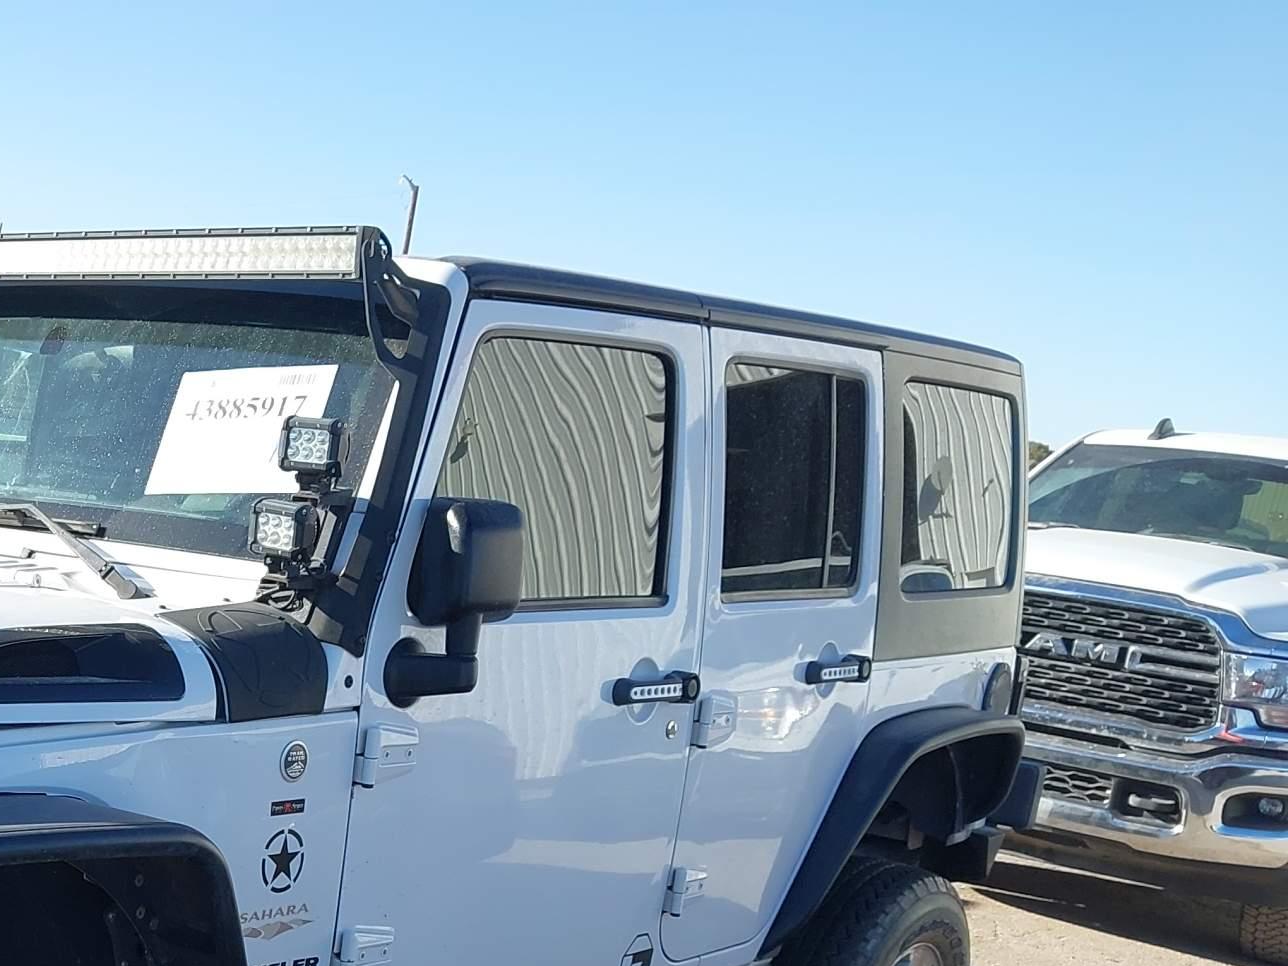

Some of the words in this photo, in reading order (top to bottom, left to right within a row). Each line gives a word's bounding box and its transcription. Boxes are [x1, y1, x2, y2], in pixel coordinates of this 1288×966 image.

[186, 395, 307, 421] 43885917
[1025, 632, 1119, 663] AM
[240, 903, 309, 924] SAHARA
